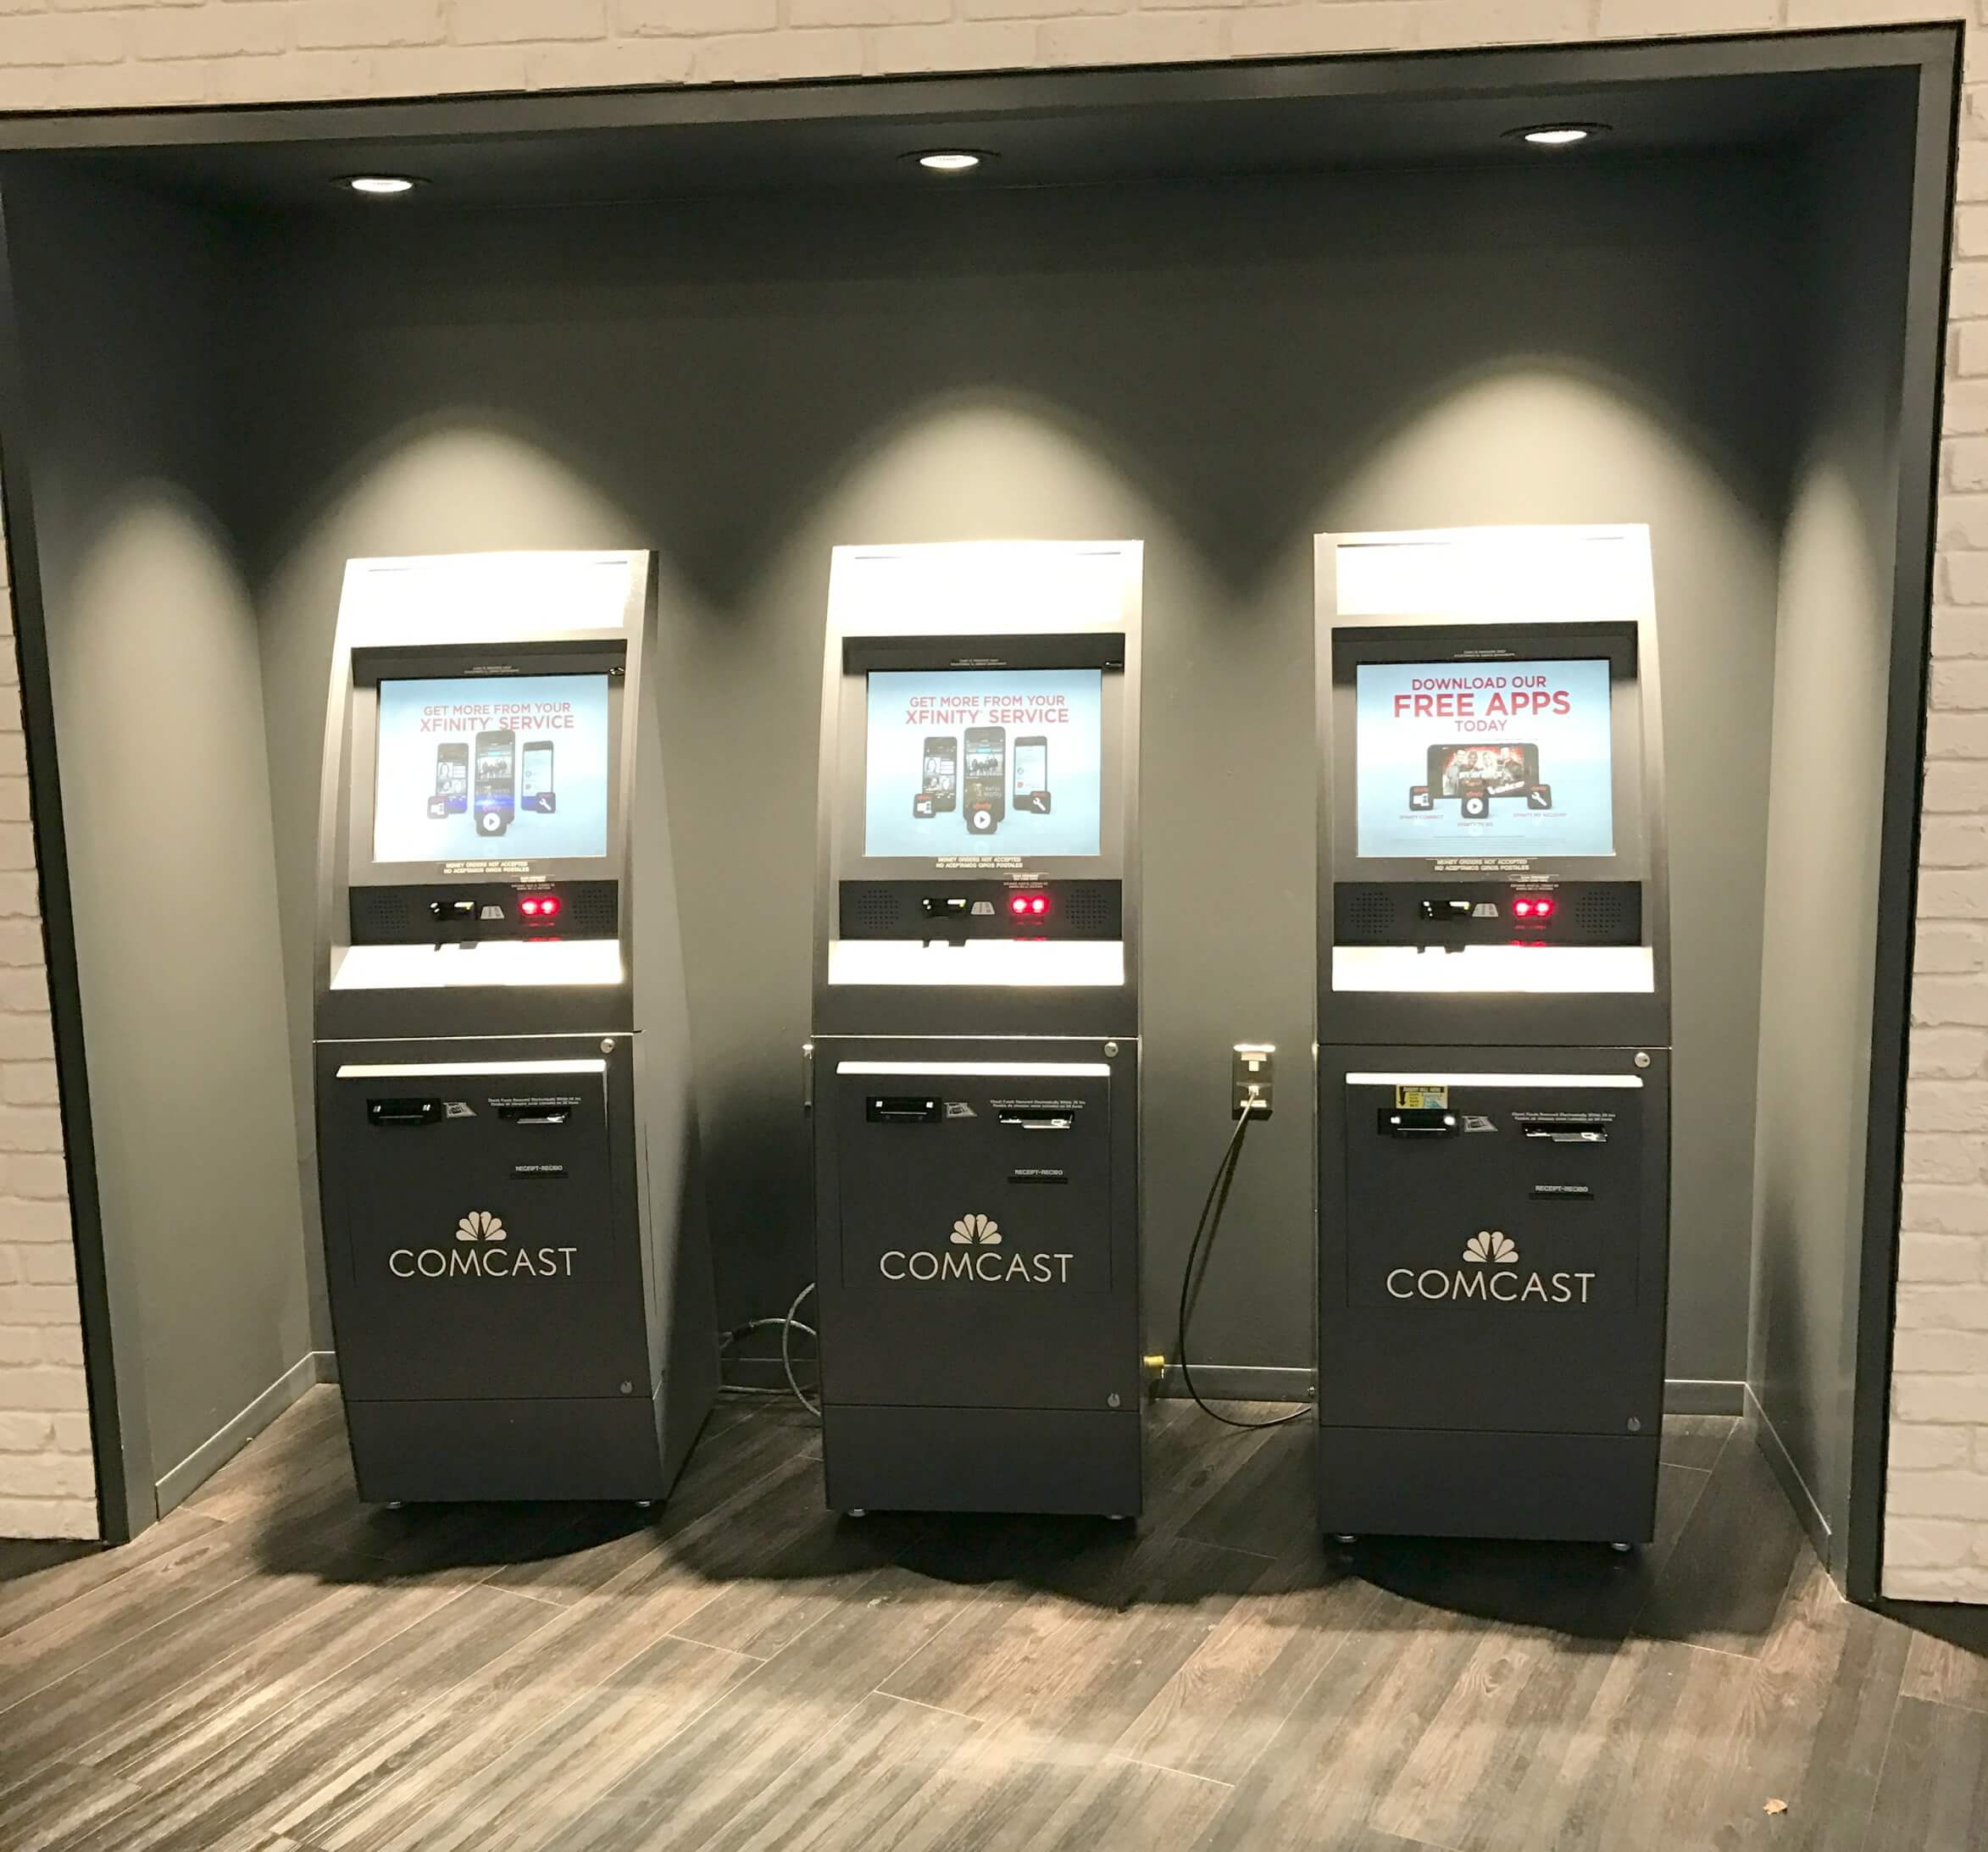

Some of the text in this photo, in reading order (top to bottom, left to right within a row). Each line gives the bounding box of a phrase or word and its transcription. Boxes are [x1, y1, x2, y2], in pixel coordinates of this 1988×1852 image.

[1411, 675, 1547, 690] DOWNLOAD OUR
[909, 695, 1065, 707] GET MORE FROM YOUR
[1393, 690, 1571, 718] FREE APPS
[423, 702, 570, 717] GET MORE FROM YOUR
[905, 708, 1069, 724] XFINITY SERVICE
[420, 715, 575, 732] XFINITY SERVICE
[1454, 719, 1508, 732] TODAY
[389, 1247, 577, 1278] COMCAST
[880, 1250, 1074, 1283] COMCAST
[1386, 1268, 1596, 1303] COMCAST
